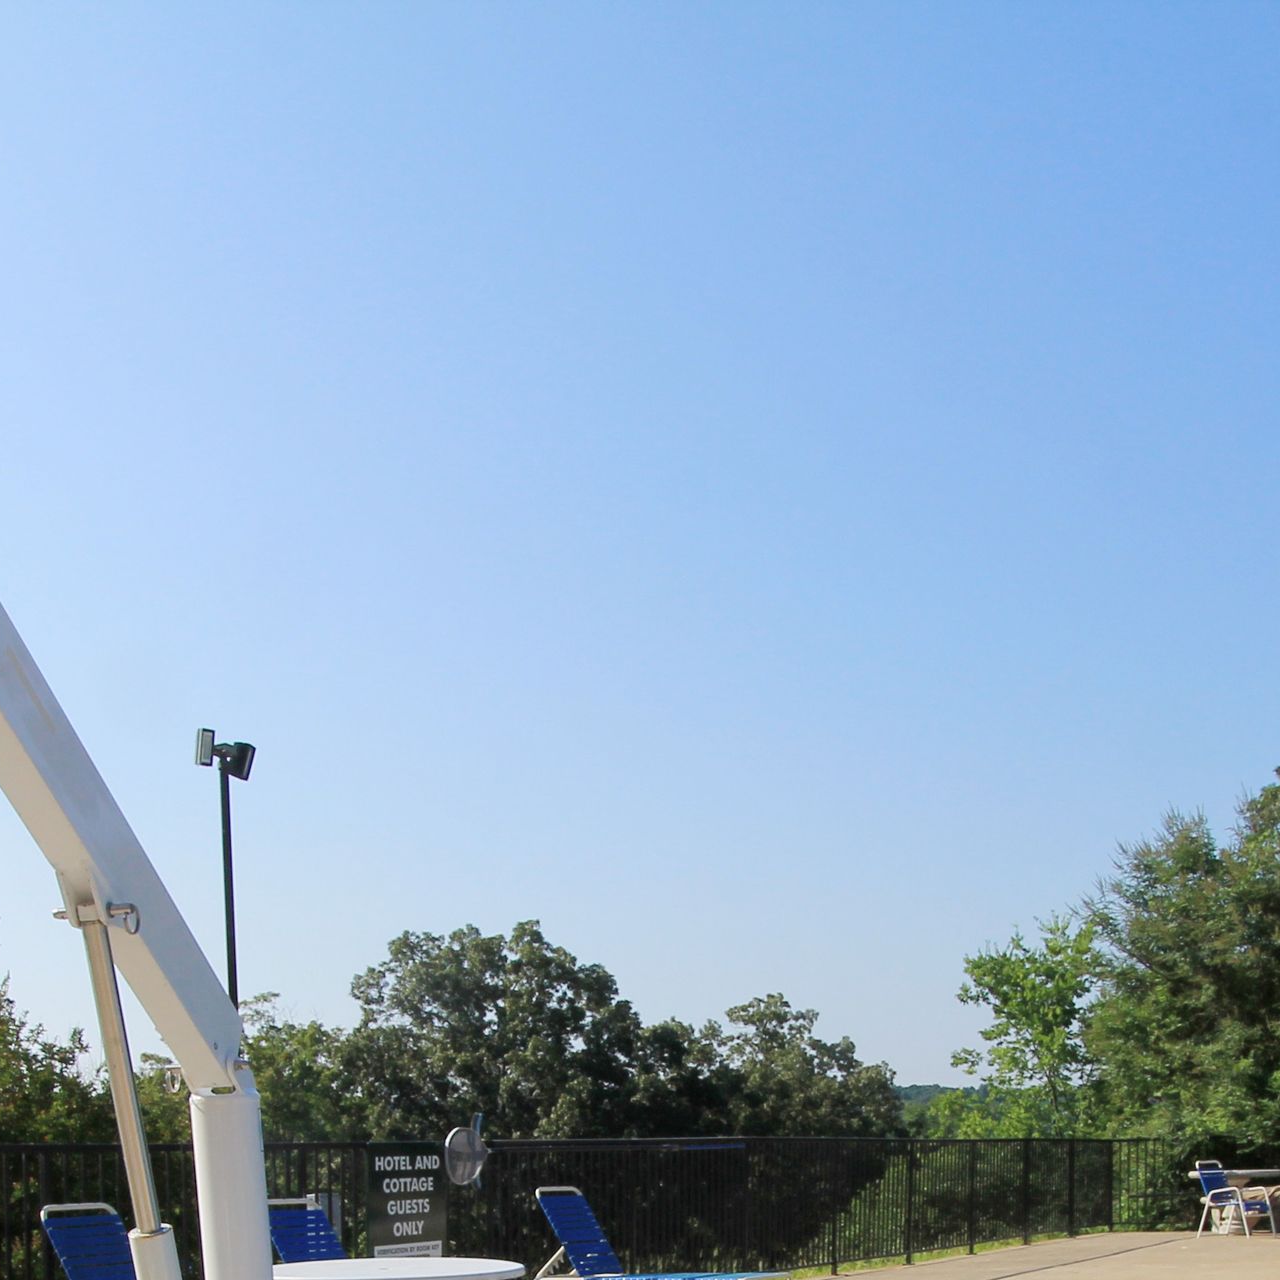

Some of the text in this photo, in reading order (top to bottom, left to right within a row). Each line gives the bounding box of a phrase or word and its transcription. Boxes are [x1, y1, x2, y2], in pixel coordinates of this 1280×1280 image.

[375, 1155, 440, 1171] HOTEL AND
[383, 1177, 434, 1193] COTTAGE
[387, 1199, 430, 1215] GUESTS
[393, 1221, 424, 1237] ONLY
